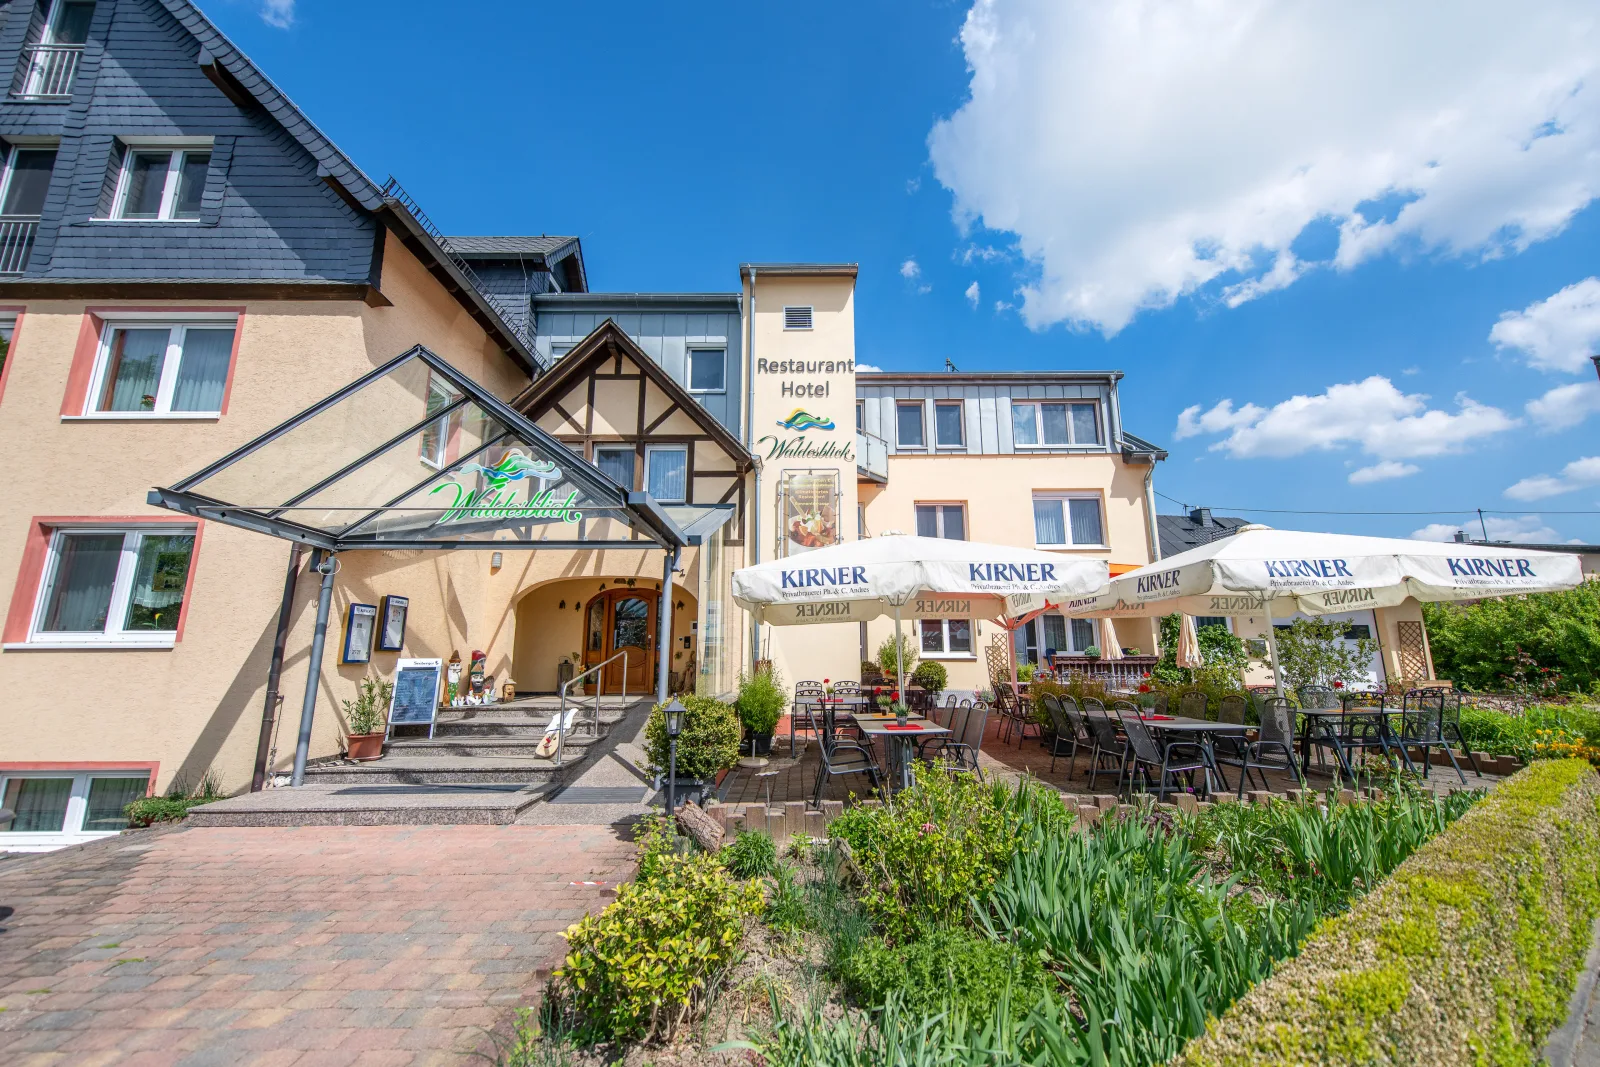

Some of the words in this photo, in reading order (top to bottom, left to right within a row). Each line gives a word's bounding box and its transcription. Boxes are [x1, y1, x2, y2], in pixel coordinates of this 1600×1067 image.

[757, 357, 854, 374] Restaurant
[781, 381, 830, 398] Hotel
[757, 435, 855, 462] Waldesblick
[428, 481, 583, 524] Waldesblick
[781, 566, 869, 588] KIRNER
[969, 563, 1058, 582] KIRNER
[1264, 559, 1353, 578] KIRNER
[1446, 558, 1537, 577] KIRNER
[1137, 570, 1181, 593] KIRNER
[1270, 579, 1310, 587] Privatbrauerei
[782, 589, 822, 598] Privatbrauerei
[849, 586, 870, 594] Andres
